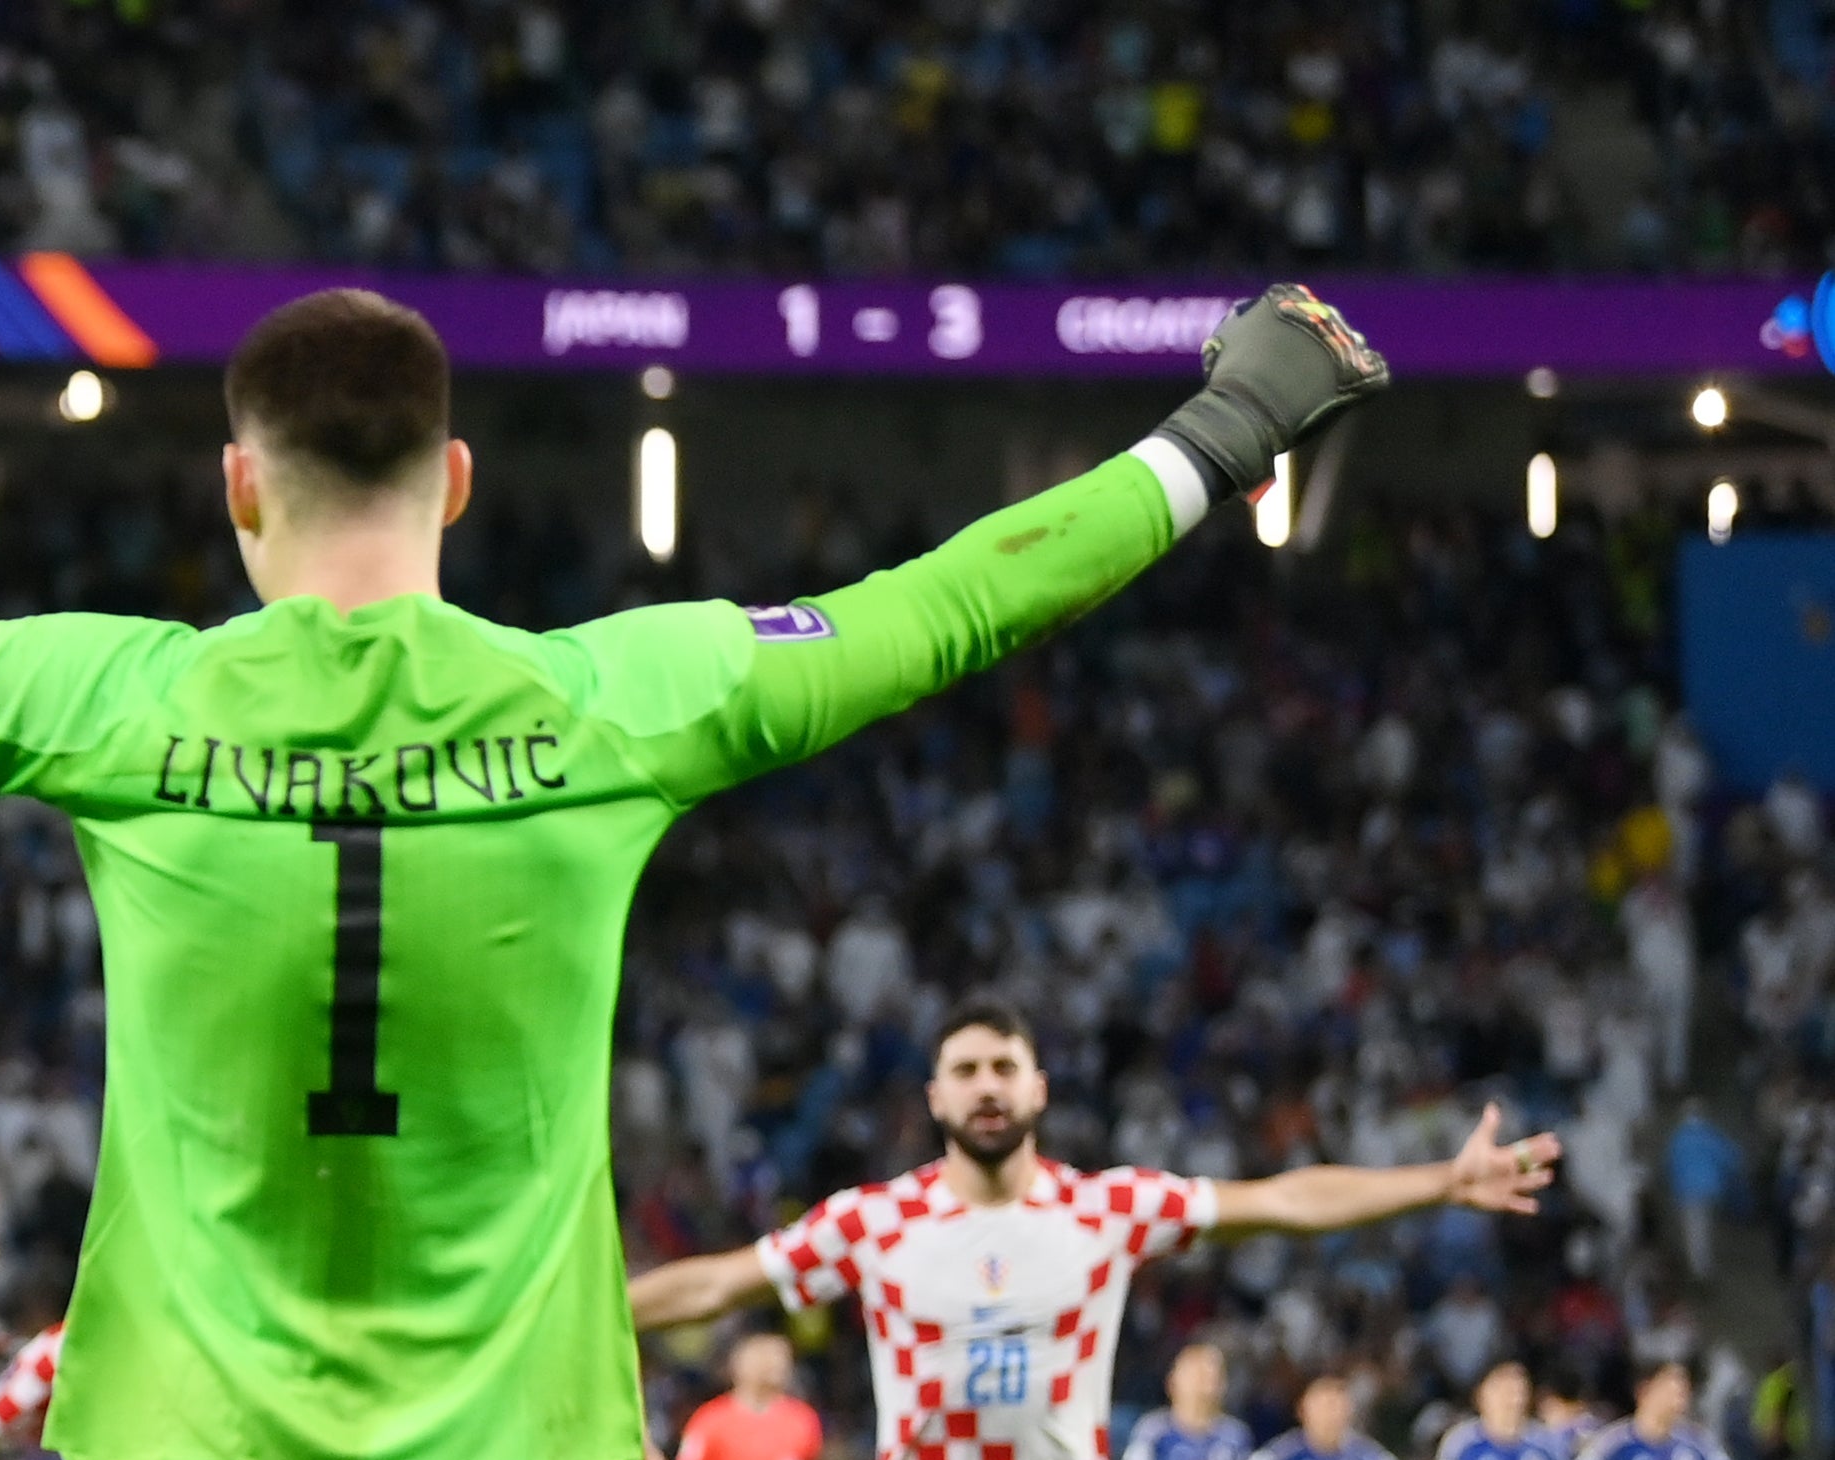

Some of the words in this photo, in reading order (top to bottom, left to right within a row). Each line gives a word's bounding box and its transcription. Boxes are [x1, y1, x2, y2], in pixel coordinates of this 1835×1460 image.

[777, 284, 820, 358] 1
[928, 284, 984, 360] 3
[1056, 296, 1232, 354] CROAT
[154, 720, 567, 816] LIVAKOVIĆ
[306, 822, 400, 1137] 1
[965, 1336, 1028, 1407] 20
